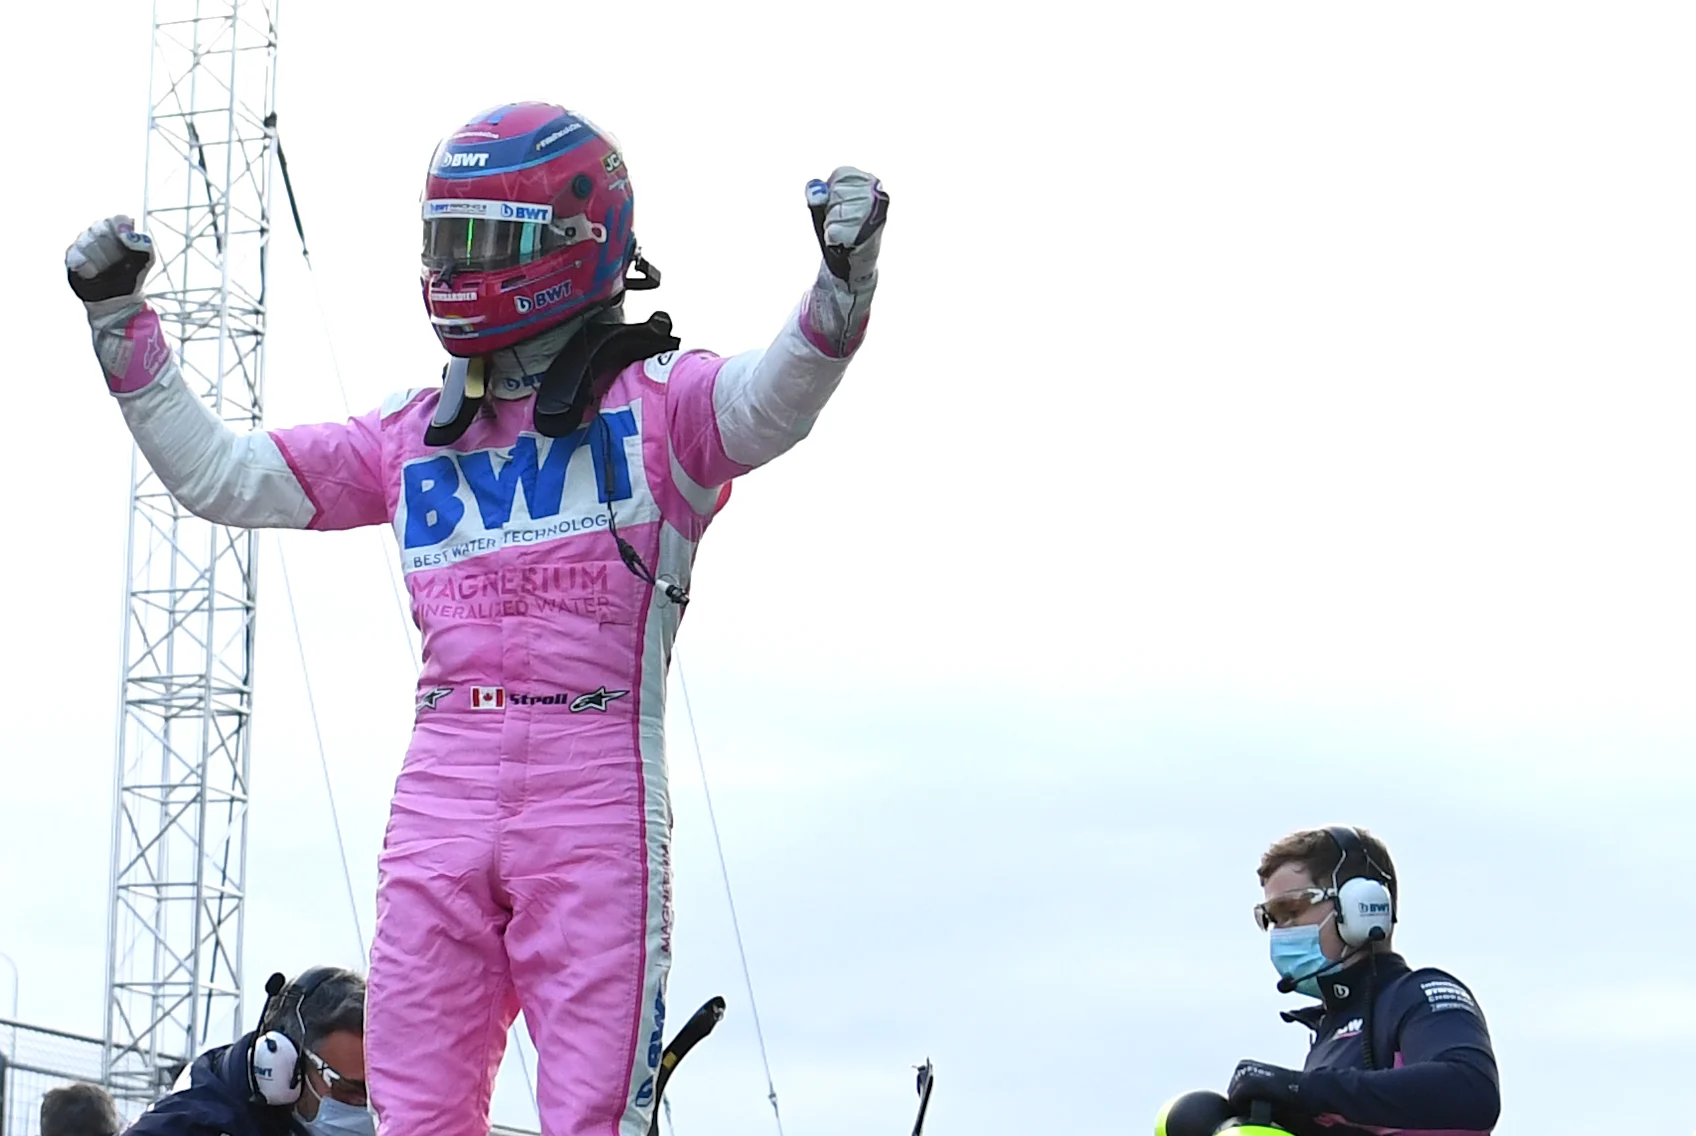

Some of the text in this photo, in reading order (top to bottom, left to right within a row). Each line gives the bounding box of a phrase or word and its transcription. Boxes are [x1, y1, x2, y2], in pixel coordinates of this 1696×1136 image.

[451, 153, 489, 167] BWT
[515, 205, 549, 220] BWT
[535, 279, 572, 307] BWT
[404, 404, 639, 551] BWT
[412, 511, 619, 569] BEST WATER TECHNOLOGY
[411, 563, 609, 603] MAGNESIUM
[536, 597, 611, 616] WATER
[509, 693, 569, 706] Stroll
